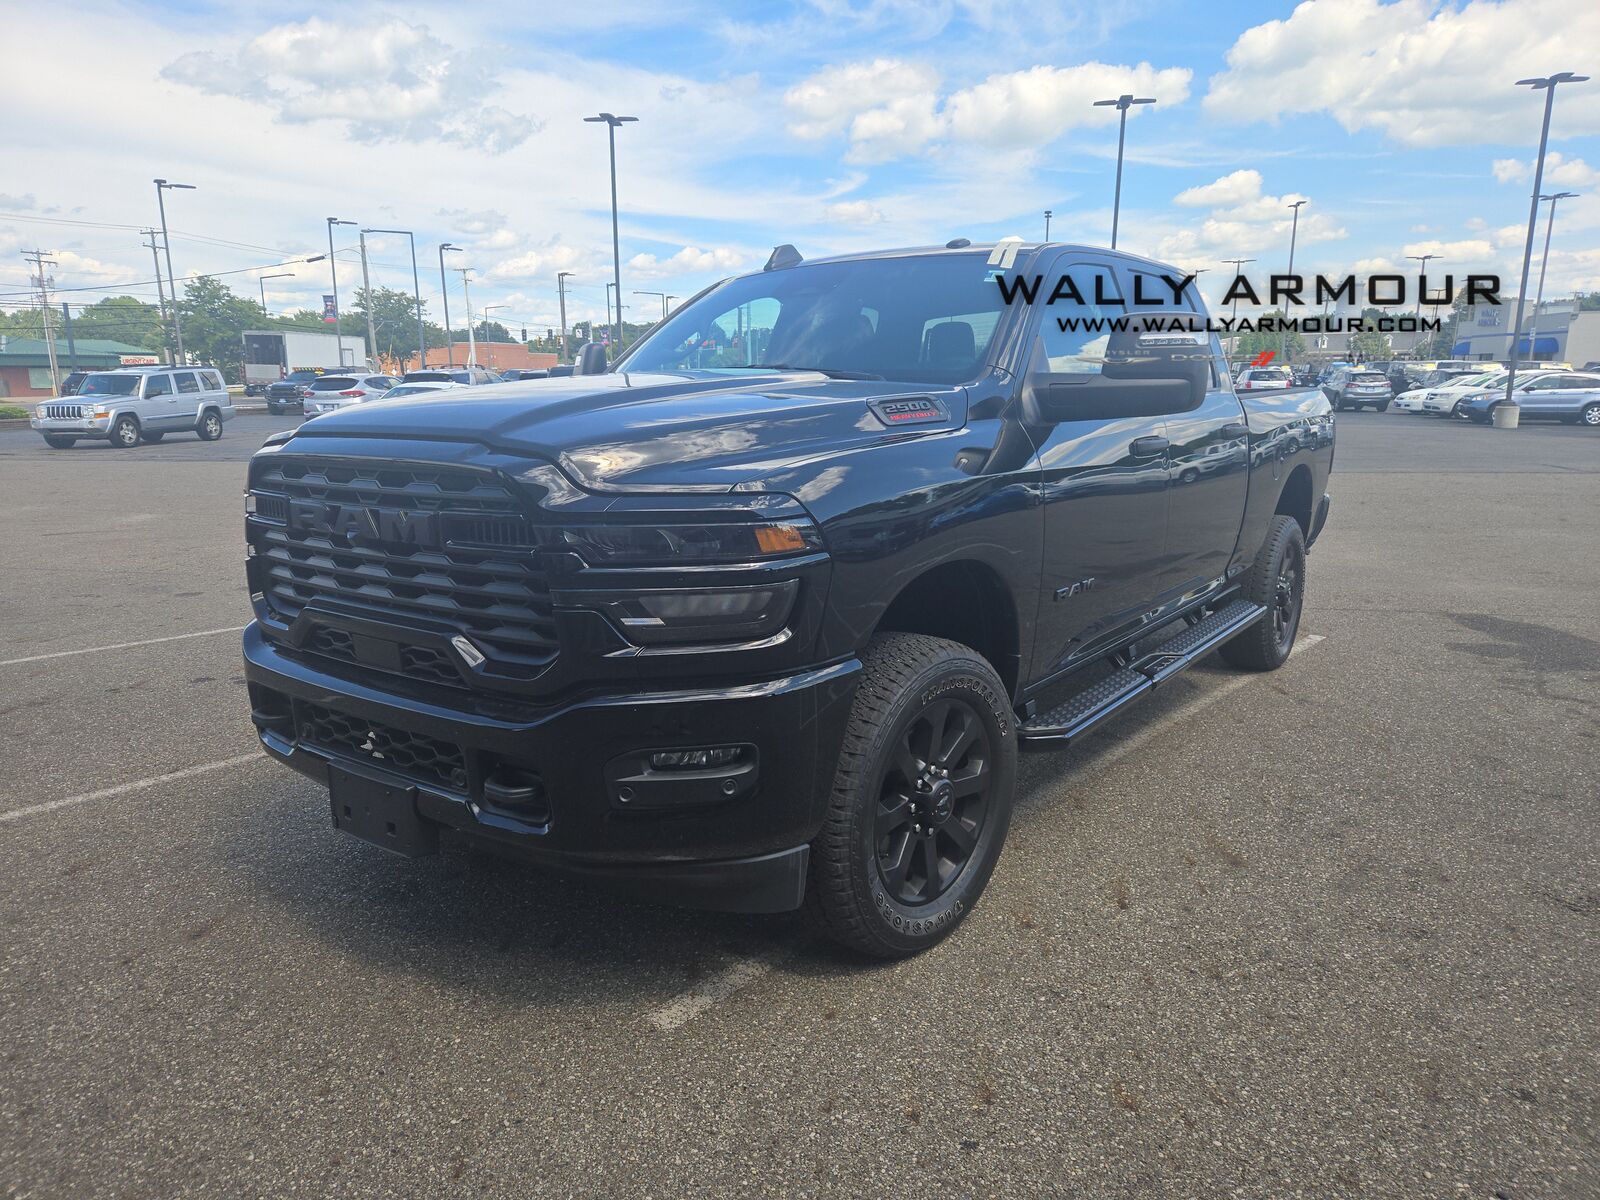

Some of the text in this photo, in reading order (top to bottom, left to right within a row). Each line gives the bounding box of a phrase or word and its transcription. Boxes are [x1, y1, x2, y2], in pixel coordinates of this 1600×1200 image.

[885, 400, 931, 414] 2500
[289, 498, 440, 547] RAM
[1054, 577, 1095, 600] RAM
[921, 677, 999, 708] TRANSFORCE
[876, 891, 964, 934] Firestone
